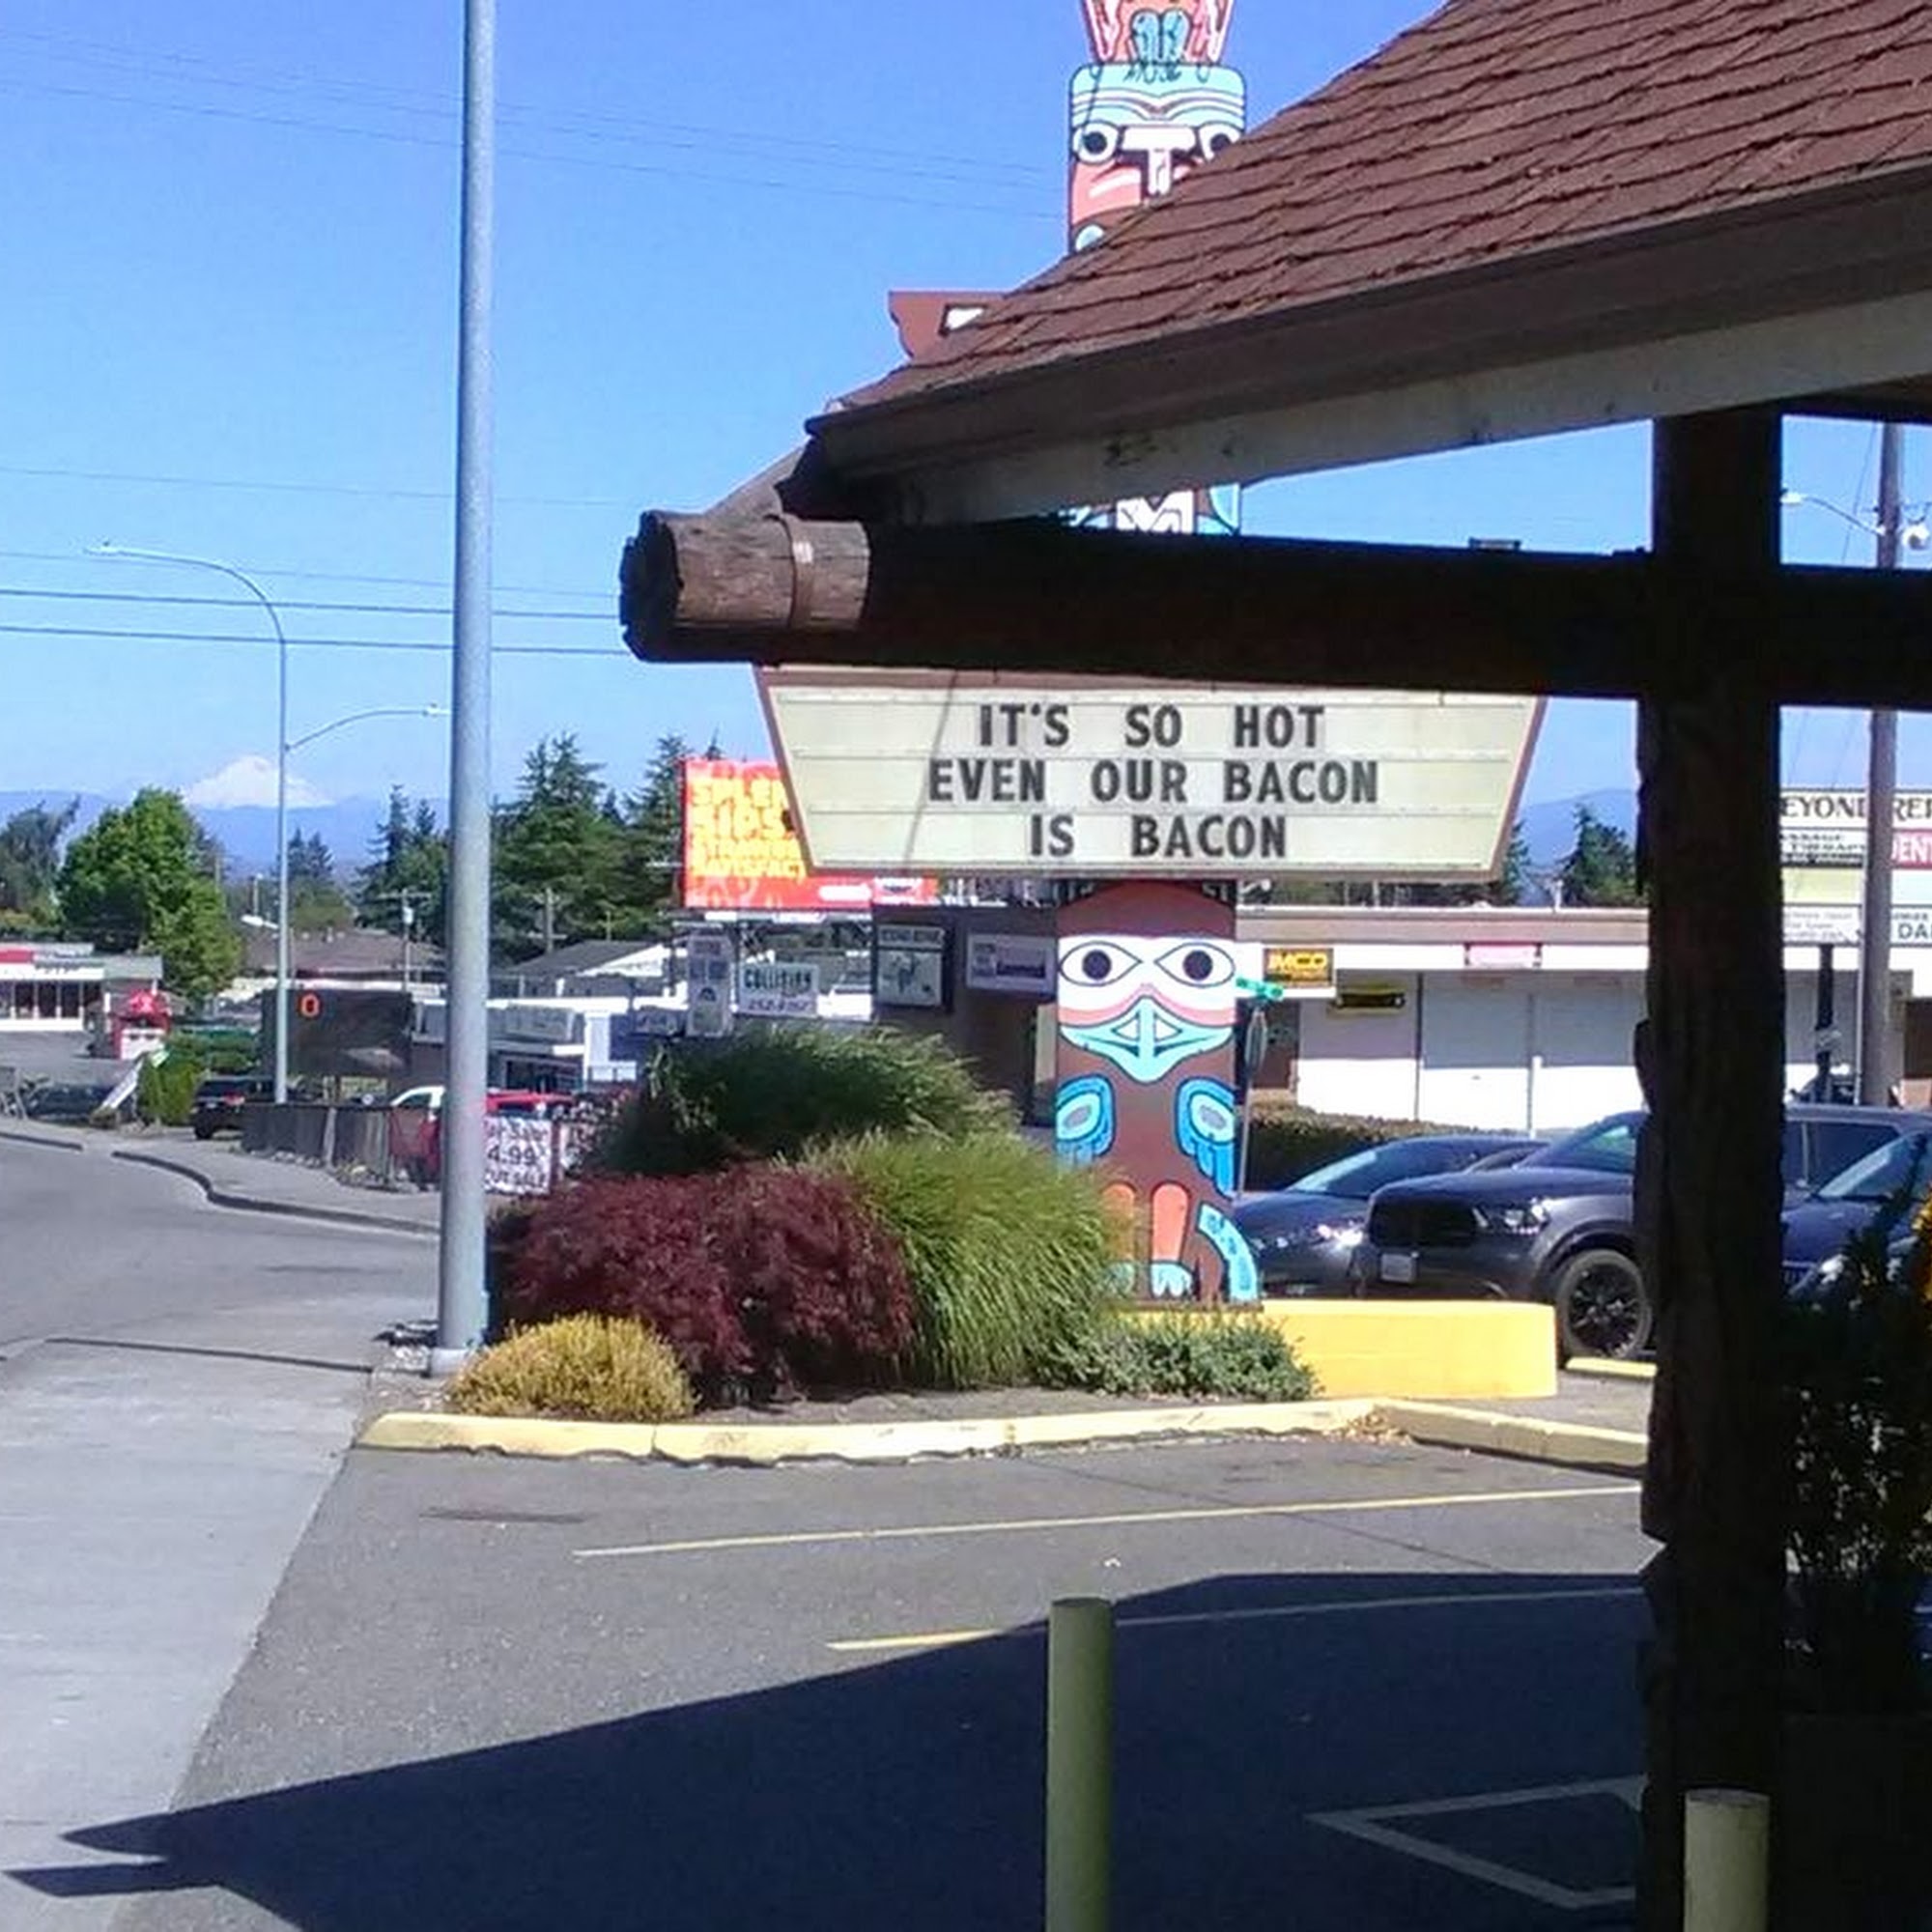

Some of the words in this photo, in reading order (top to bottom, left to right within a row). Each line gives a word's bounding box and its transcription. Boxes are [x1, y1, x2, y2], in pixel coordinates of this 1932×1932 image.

[981, 704, 1068, 746] IT'S
[1126, 705, 1180, 747] SO
[1236, 705, 1323, 747] HOT
[930, 759, 1043, 802] EVEN
[1093, 760, 1185, 802] OUR
[1225, 761, 1376, 803] BACON
[1033, 815, 1072, 856] IS
[1132, 815, 1285, 857] BACON
[1898, 923, 1932, 940] DA
